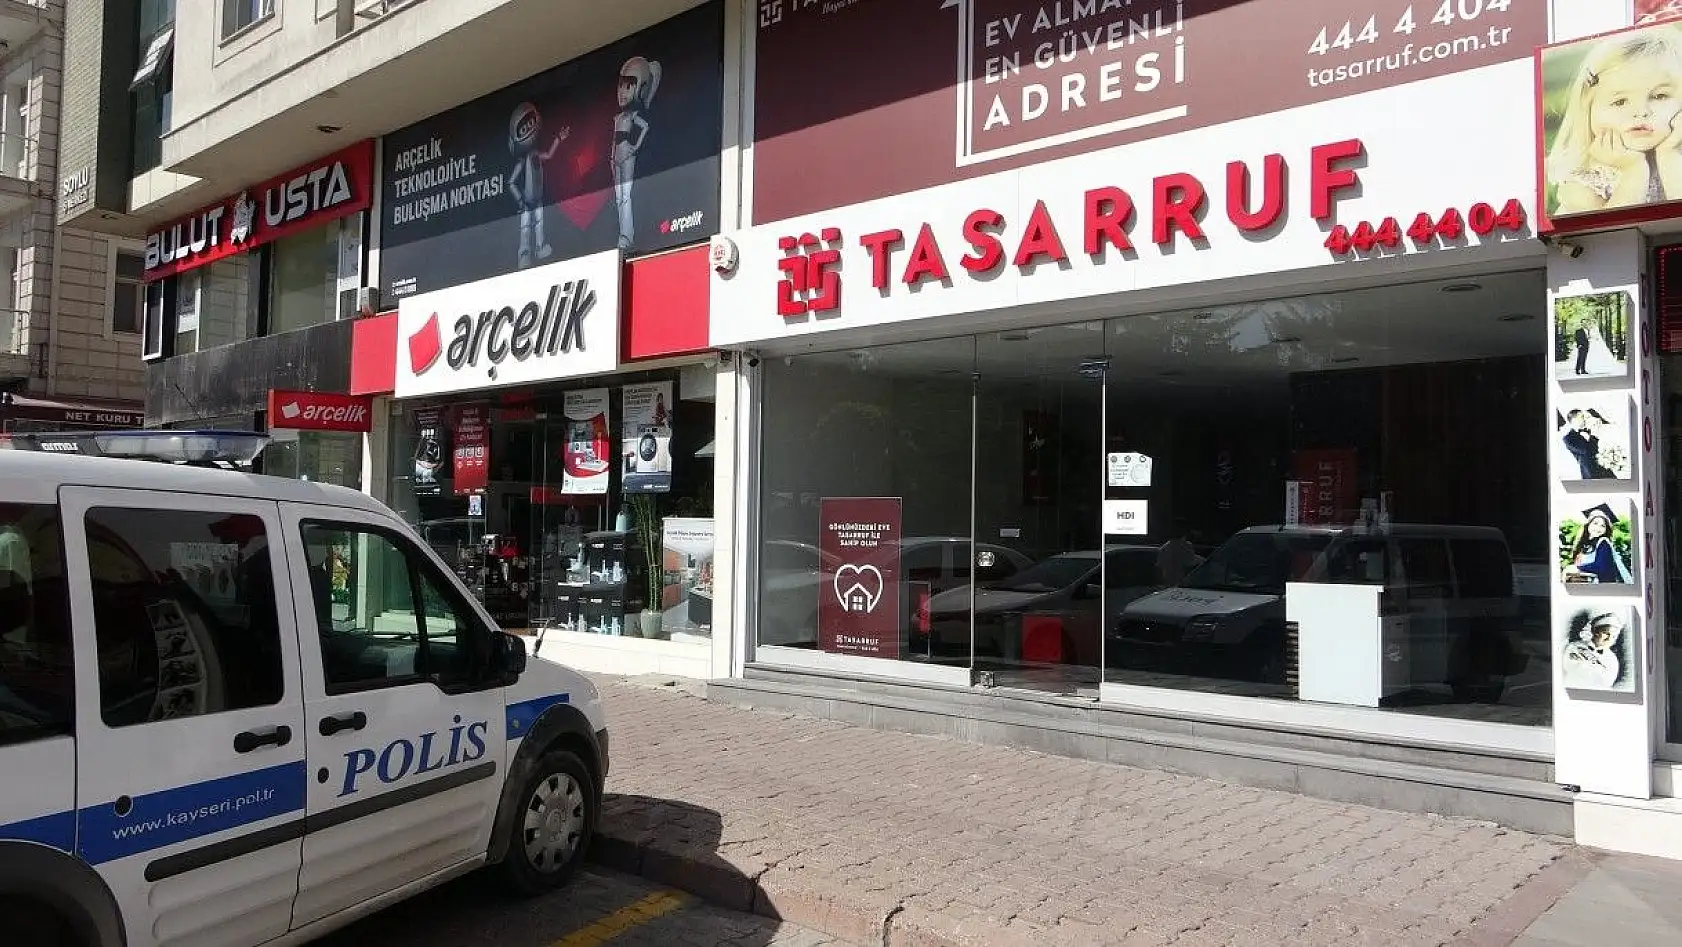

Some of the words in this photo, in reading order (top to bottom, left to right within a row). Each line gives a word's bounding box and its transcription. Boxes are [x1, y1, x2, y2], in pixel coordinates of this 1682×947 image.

[985, 14, 1021, 47] EV
[1032, 0, 1132, 33] ALMA
[985, 51, 1020, 84] EN
[1034, 0, 1183, 69] GÜVENLİ
[1308, 14, 1379, 55] 444
[1393, 5, 1417, 34] 4
[1308, 26, 1512, 87] tasarruf.com.tr
[983, 36, 1186, 131] ADRESİ
[394, 154, 476, 198] TEKNOLOJİYLE
[395, 137, 442, 172] ARÇELİK
[144, 206, 225, 269] BULUT
[264, 160, 352, 226] USTA
[393, 191, 449, 225] BULUŞMA
[450, 174, 504, 208] NOKTASI
[858, 137, 1366, 291] TASARRUF
[1324, 216, 1401, 254] 444
[447, 279, 597, 380] arçelik
[65, 411, 92, 421] NET
[96, 413, 131, 424] KURU
[303, 404, 367, 425] arçelik
[1117, 511, 1135, 520] HDI
[337, 714, 488, 798] POLİS
[112, 788, 275, 840] www.kayseri.pol.tr
